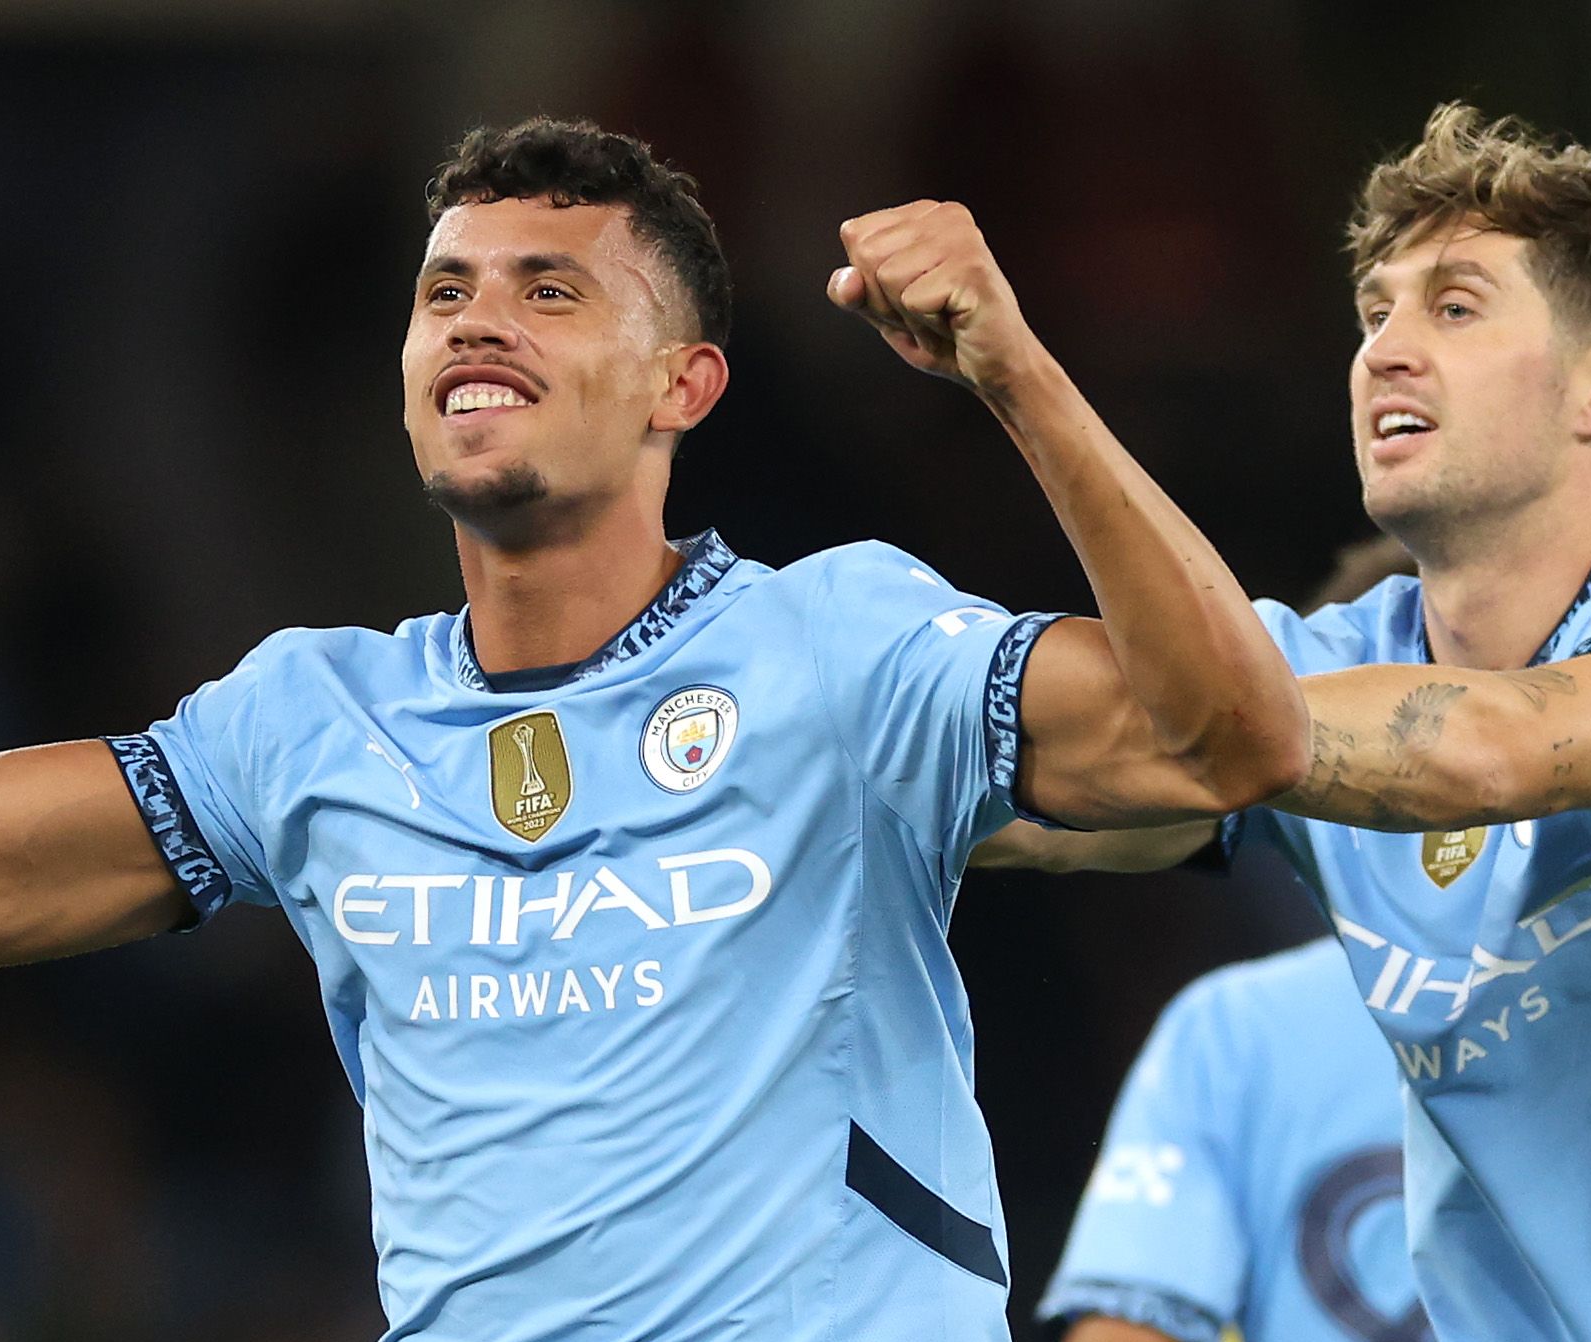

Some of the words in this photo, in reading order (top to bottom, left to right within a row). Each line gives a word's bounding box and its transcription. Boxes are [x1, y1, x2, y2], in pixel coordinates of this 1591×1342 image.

[651, 693, 732, 736] MANCHESTER
[682, 769, 709, 788] CITY
[515, 794, 553, 816] FIFA
[523, 817, 545, 830] 2023
[333, 848, 772, 946] ETIHAD
[410, 960, 664, 1020] AIRWAYS
